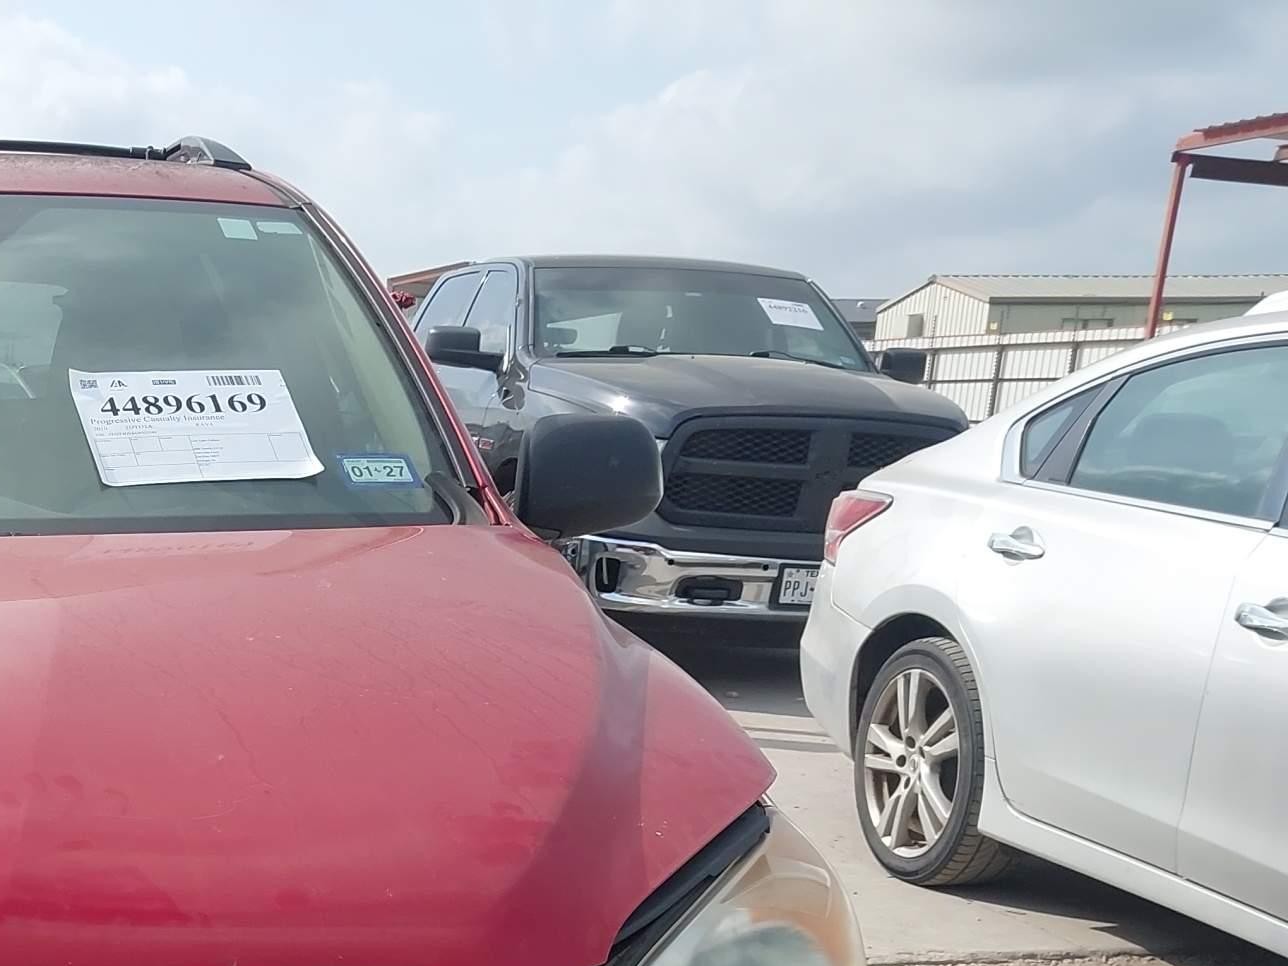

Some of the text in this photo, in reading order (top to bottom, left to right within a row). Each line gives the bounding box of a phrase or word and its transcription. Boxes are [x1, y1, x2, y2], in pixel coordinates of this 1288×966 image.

[100, 393, 267, 416] 44896169
[90, 416, 142, 425] Progressive
[143, 415, 180, 423] Casualty
